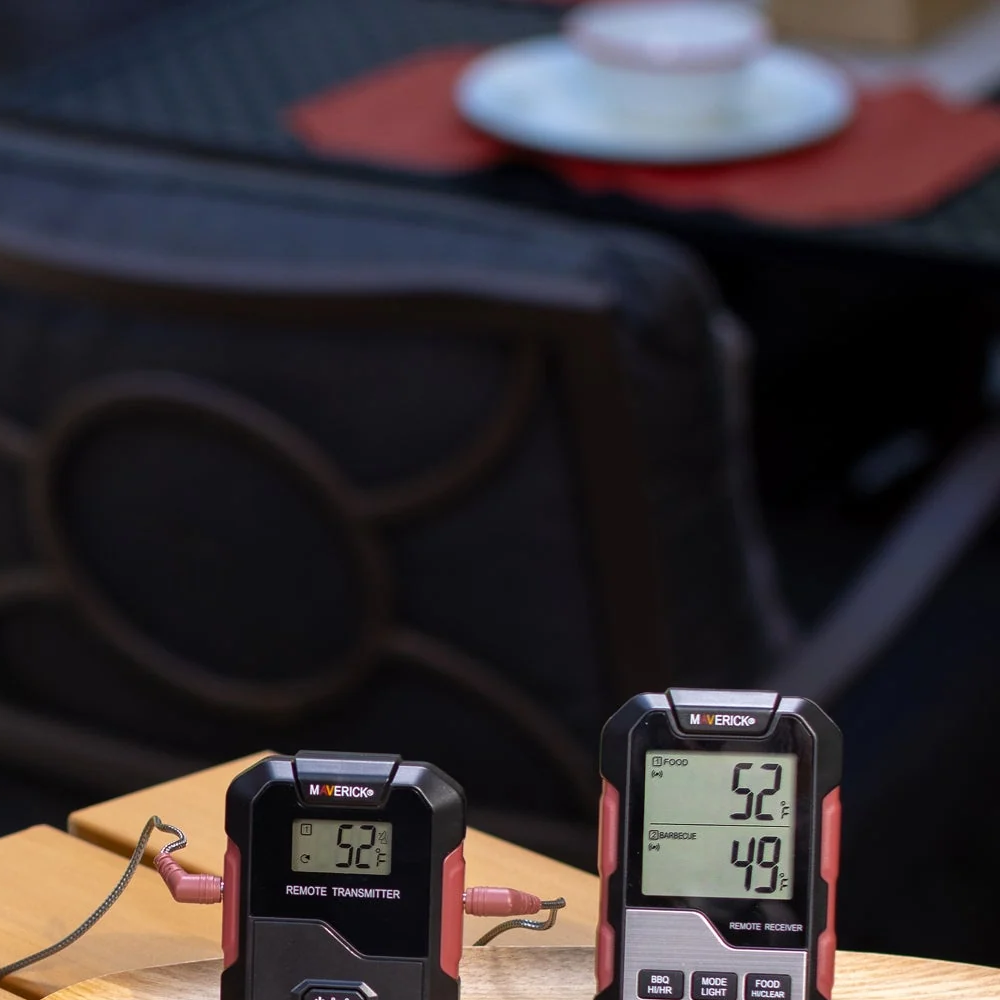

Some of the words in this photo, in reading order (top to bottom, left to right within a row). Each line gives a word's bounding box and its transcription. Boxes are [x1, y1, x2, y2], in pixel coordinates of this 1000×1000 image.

[663, 758, 688, 766] FOOD
[730, 763, 782, 821] 52
[659, 832, 697, 840] BARBECUE
[336, 824, 376, 869] 52
[730, 836, 781, 893] 49
[286, 885, 327, 896] REMOTE
[332, 887, 400, 899] TRANSMITTER
[729, 922, 761, 931] REMOTE
[765, 923, 802, 932] RECEIVER
[651, 975, 670, 985] BBQ
[701, 977, 728, 987] MODE
[755, 980, 780, 988] FOOD
[647, 986, 672, 994] HI/HR
[701, 988, 727, 997] LIGHT
[751, 990, 785, 998] HI/CLEAR
